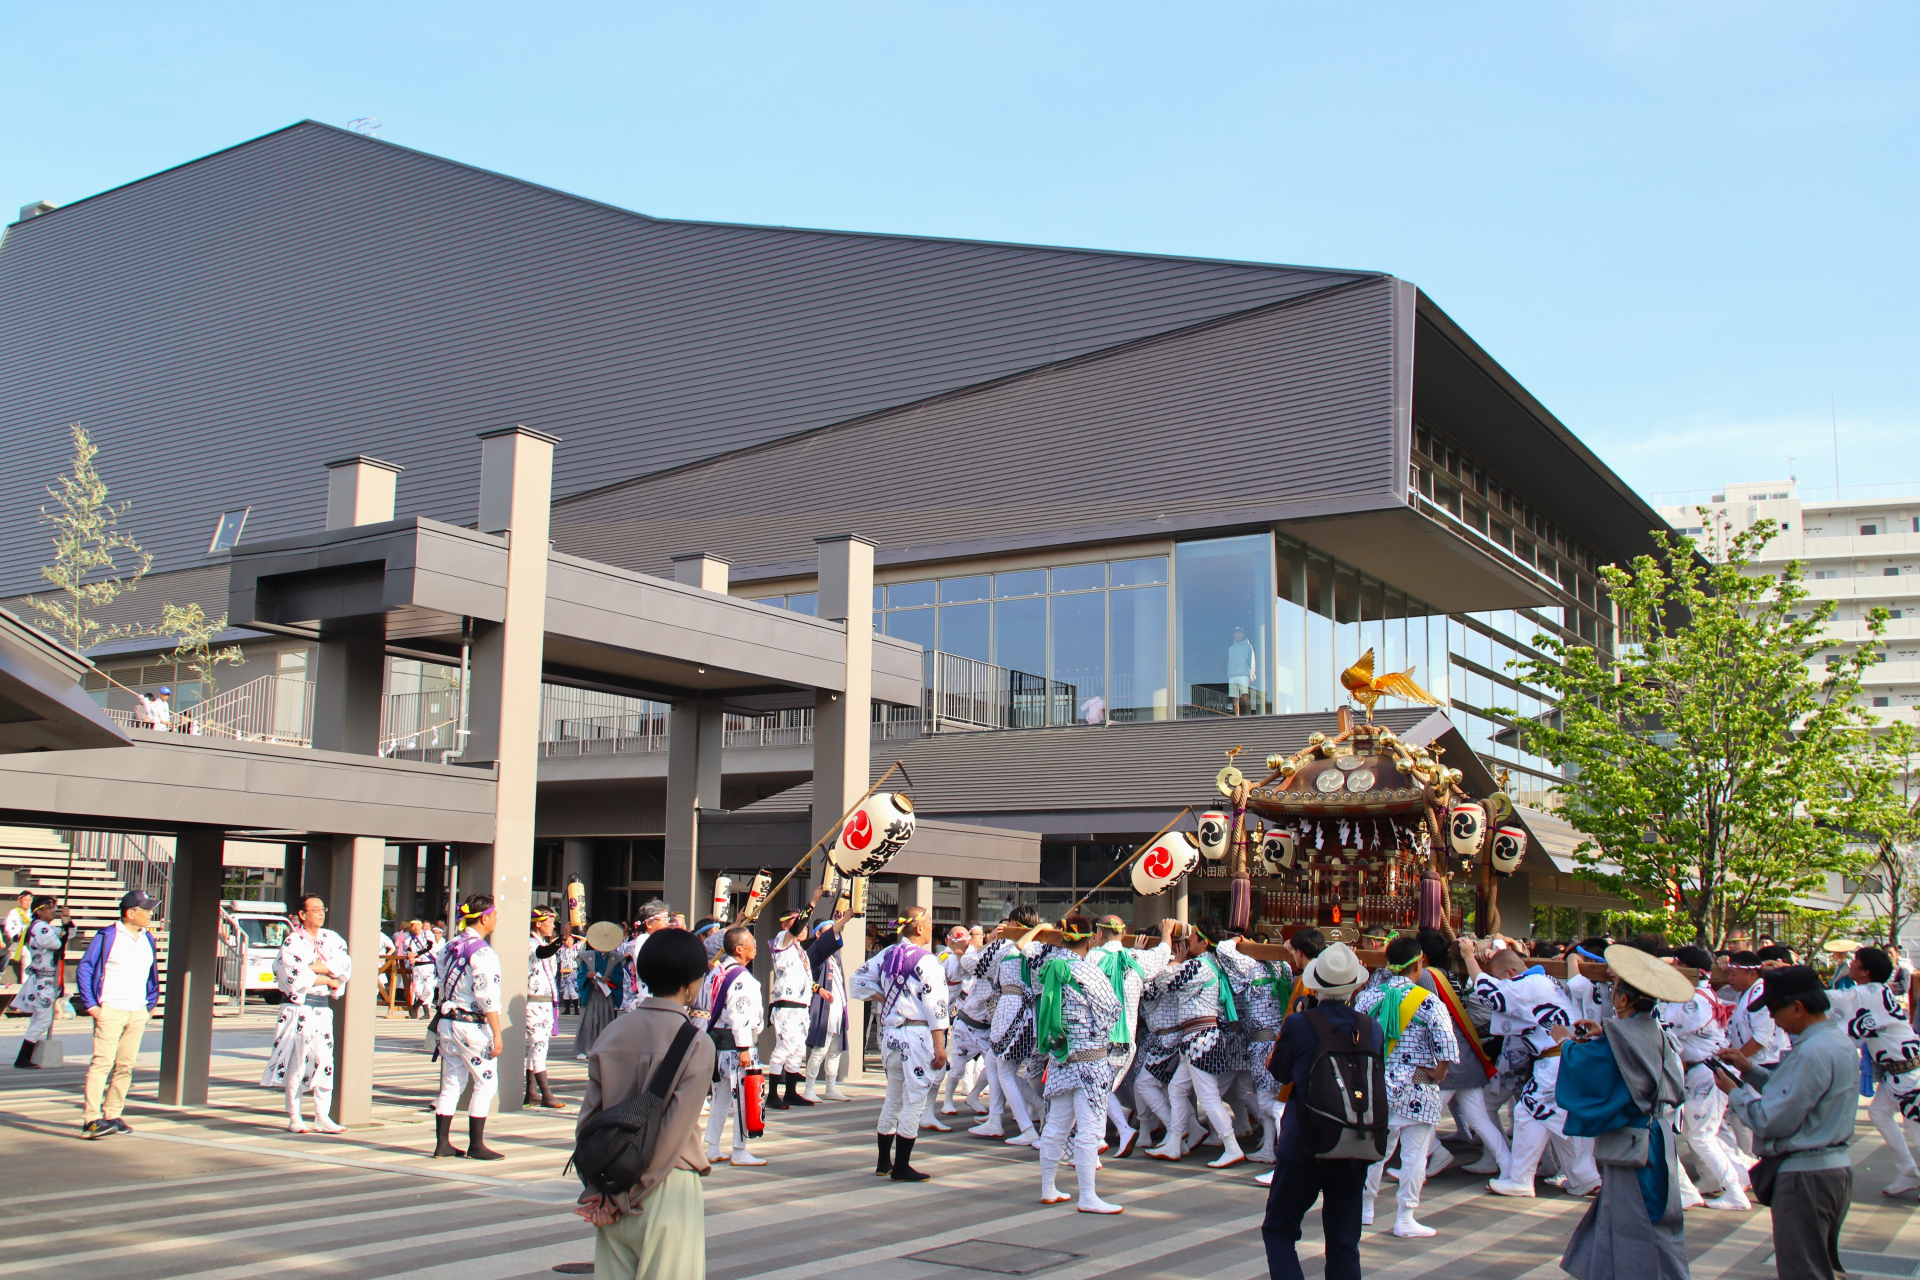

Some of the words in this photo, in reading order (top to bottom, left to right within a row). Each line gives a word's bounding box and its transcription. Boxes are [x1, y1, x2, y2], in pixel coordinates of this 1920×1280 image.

[1196, 865, 1270, 878] 小田原の丸ホ
